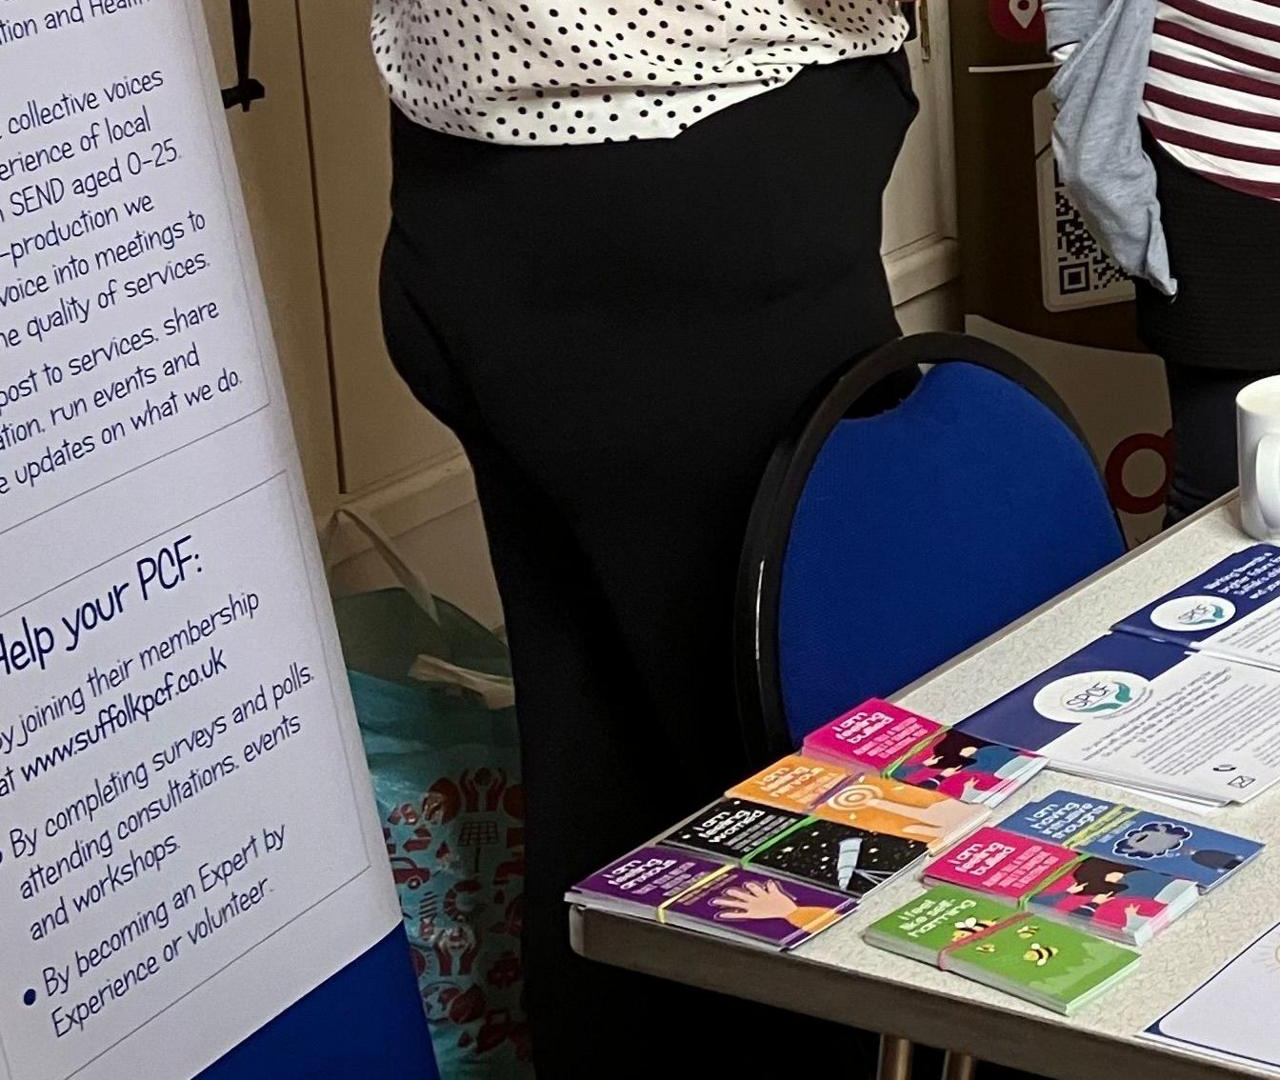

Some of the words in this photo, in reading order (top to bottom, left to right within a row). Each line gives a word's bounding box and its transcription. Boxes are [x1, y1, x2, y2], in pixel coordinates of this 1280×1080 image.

[9, 93, 99, 134] collective
[104, 71, 163, 102] voices
[10, 178, 64, 216] SEND
[72, 158, 122, 197] aged
[128, 138, 181, 175] 0-25.
[0, 276, 49, 307] voice
[53, 255, 89, 285] into
[95, 222, 184, 270] meetings
[187, 211, 205, 232] to
[15, 436, 95, 487] updates
[102, 423, 125, 444] on
[130, 392, 178, 430] what
[185, 385, 213, 406] we
[218, 368, 242, 392] do.
[62, 583, 129, 651] your
[137, 535, 202, 600] PCF:
[17, 680, 88, 747] joining
[87, 659, 133, 694] their
[139, 593, 258, 670] membership
[21, 647, 227, 781] www.suffolkpcf.co.uk
[10, 828, 36, 858] By
[46, 762, 148, 837] completing
[152, 716, 227, 771] surveys
[232, 685, 267, 723] and
[272, 662, 314, 709] polls.
[20, 830, 113, 899] attending
[118, 756, 239, 840] consultations.
[244, 715, 300, 762] events
[699, 810, 750, 838] feeling
[702, 812, 731, 829] am
[956, 843, 984, 860] am
[30, 896, 69, 940] and
[73, 836, 180, 912] workshops.
[43, 966, 69, 996] By
[75, 902, 169, 977] becoming
[173, 884, 196, 909] an
[199, 836, 258, 892] Expert
[263, 825, 285, 853] by
[51, 957, 160, 1038] Experience
[163, 936, 182, 962] or
[187, 878, 272, 944] volunteer.
